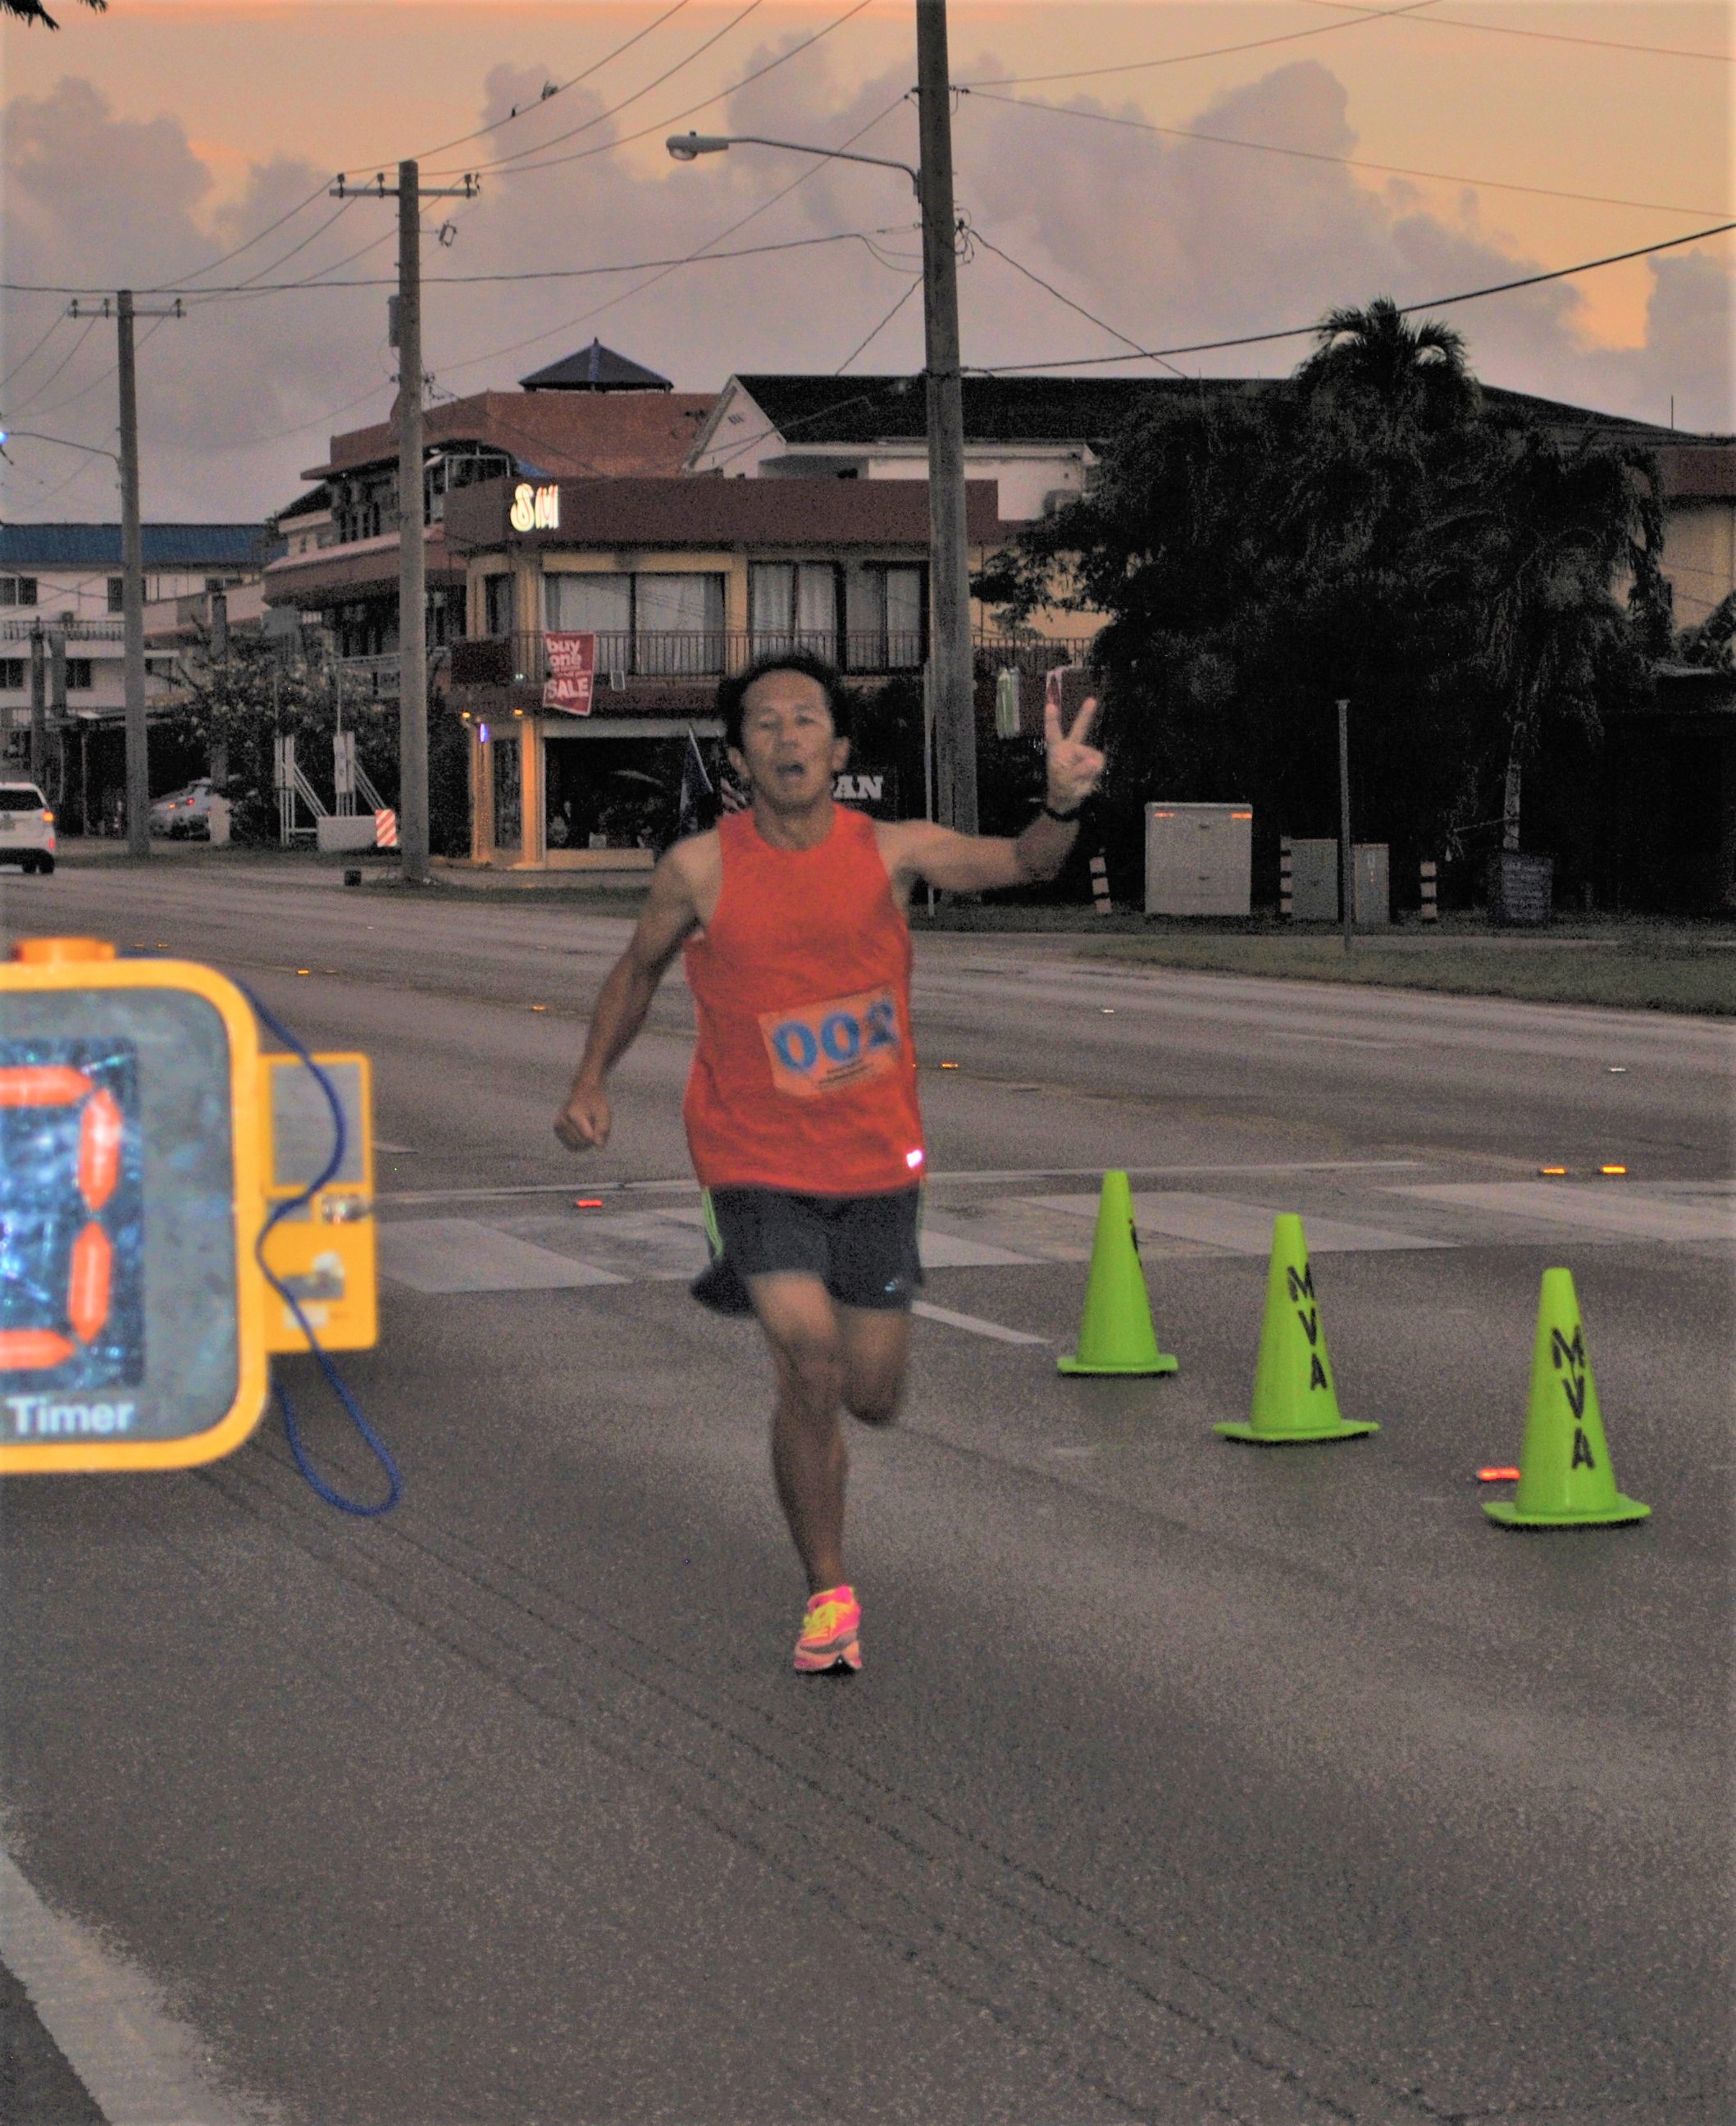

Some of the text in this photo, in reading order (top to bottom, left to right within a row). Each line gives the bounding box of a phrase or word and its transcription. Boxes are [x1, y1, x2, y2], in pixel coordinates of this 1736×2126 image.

[510, 483, 558, 532] SM
[546, 638, 581, 656] buy
[547, 677, 590, 699] SALE
[5, 1396, 135, 1435] Timer
